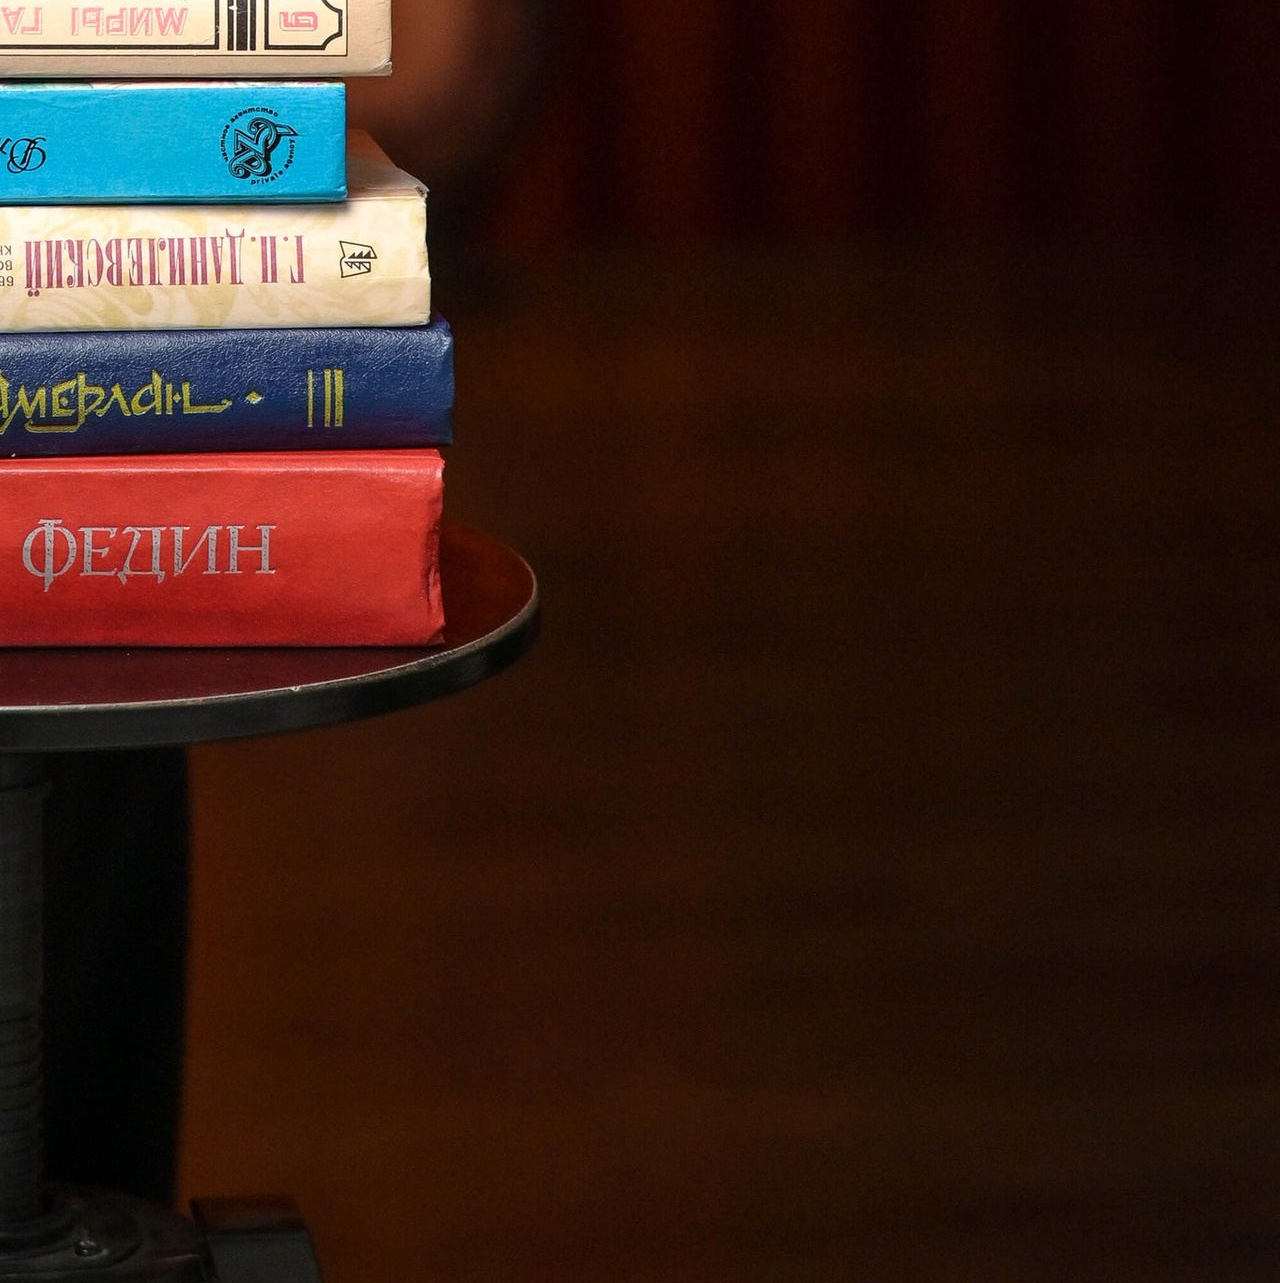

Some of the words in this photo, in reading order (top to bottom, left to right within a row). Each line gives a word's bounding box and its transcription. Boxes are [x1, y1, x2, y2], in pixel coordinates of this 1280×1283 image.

[70, 6, 189, 36] МИРЫ
[24, 228, 246, 298] ДАНИЛЕВСКИЙ
[20, 518, 278, 593] ФЕДИН
